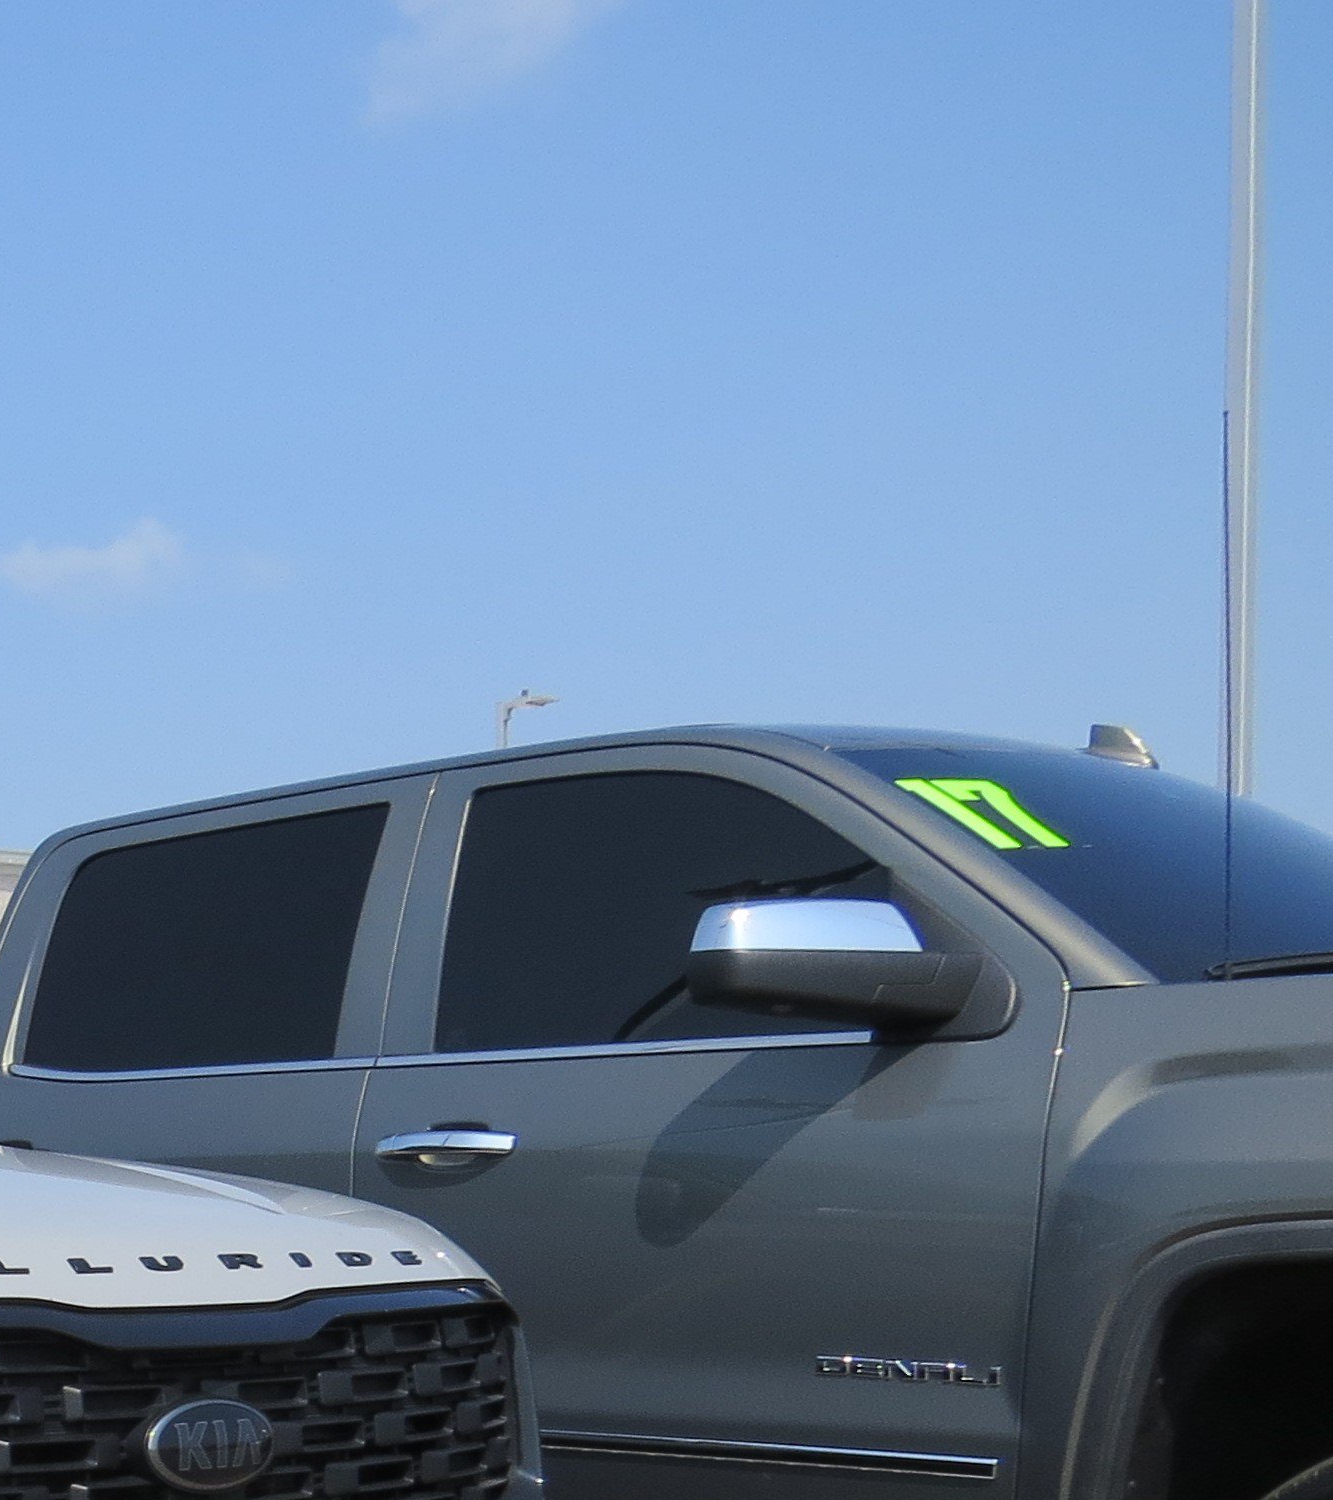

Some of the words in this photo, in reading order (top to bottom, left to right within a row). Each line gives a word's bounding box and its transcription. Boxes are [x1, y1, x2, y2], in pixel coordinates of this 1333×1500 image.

[894, 778, 1072, 850] 17
[816, 1355, 1003, 1386] DENALI
[174, 1419, 262, 1471] KIA
